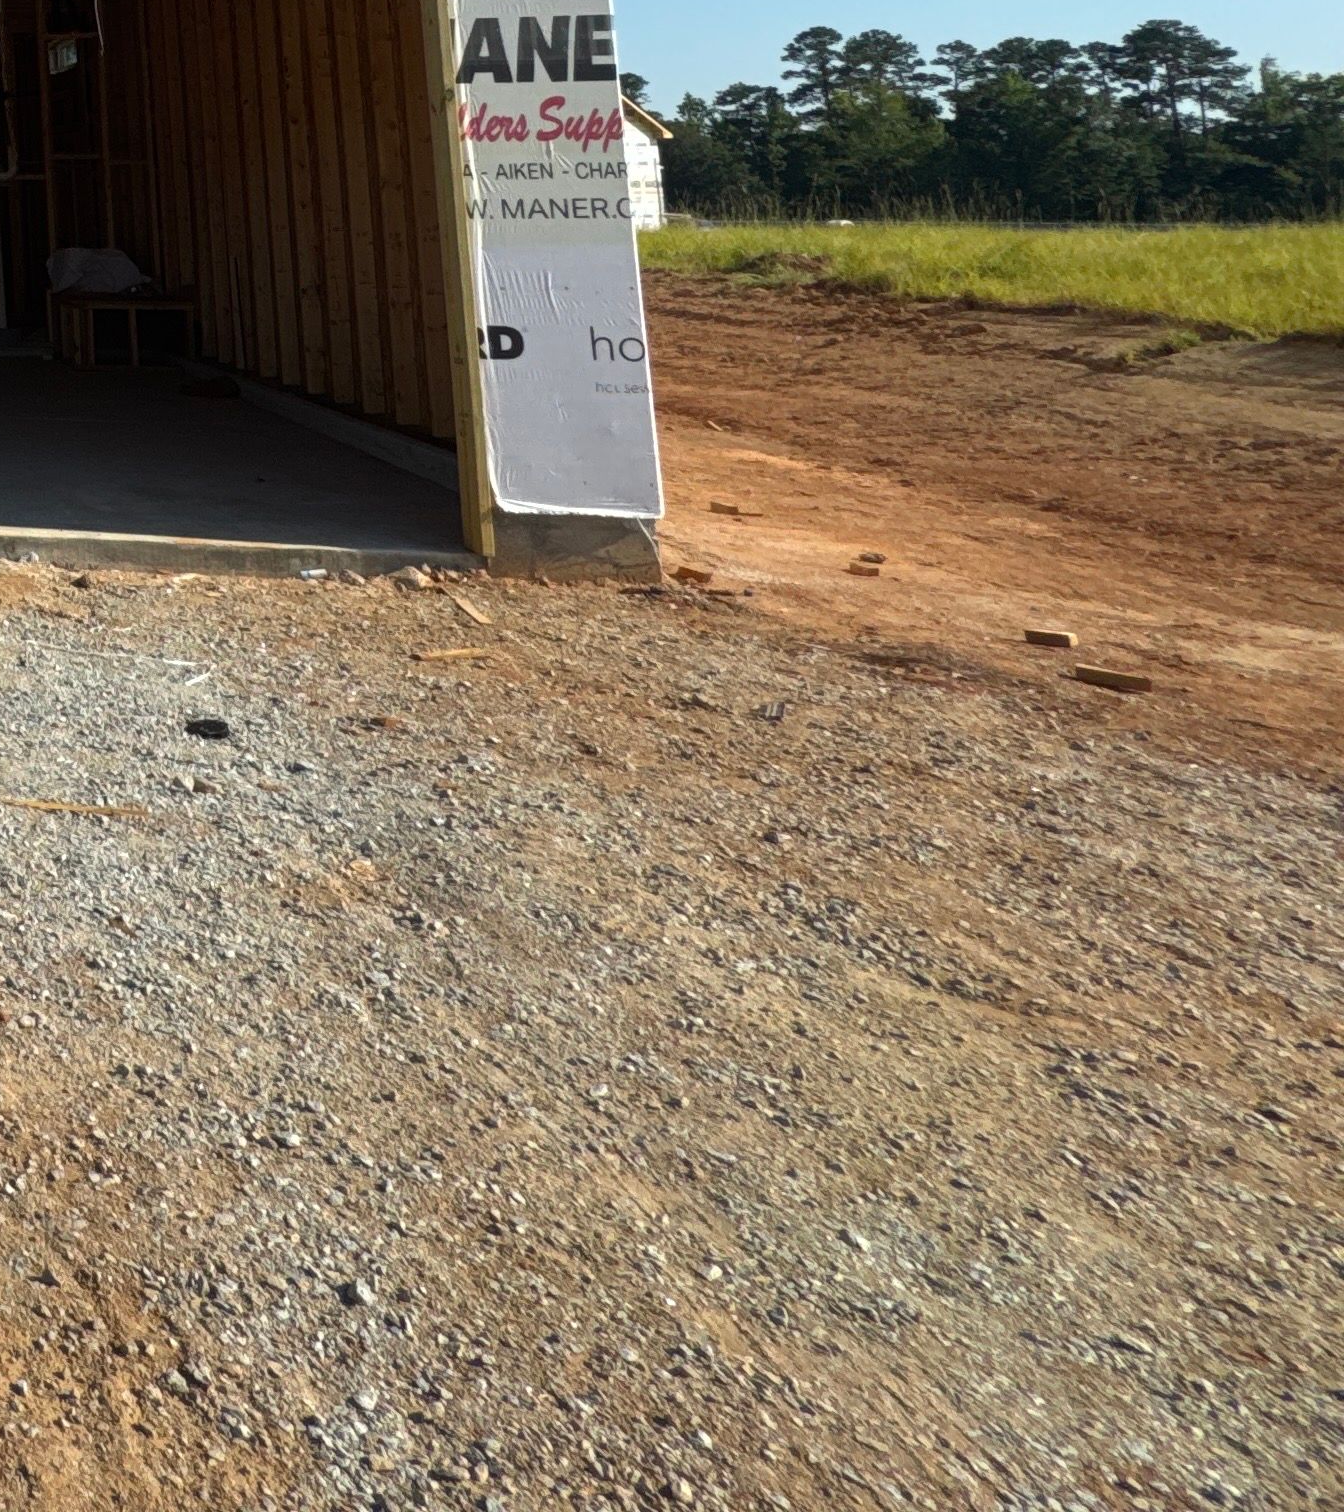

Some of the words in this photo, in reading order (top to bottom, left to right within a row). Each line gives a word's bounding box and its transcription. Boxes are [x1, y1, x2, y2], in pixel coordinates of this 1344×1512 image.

[536, 95, 625, 154] Supp
[495, 161, 554, 180] AIKEN
[500, 197, 634, 220] MANER.C
